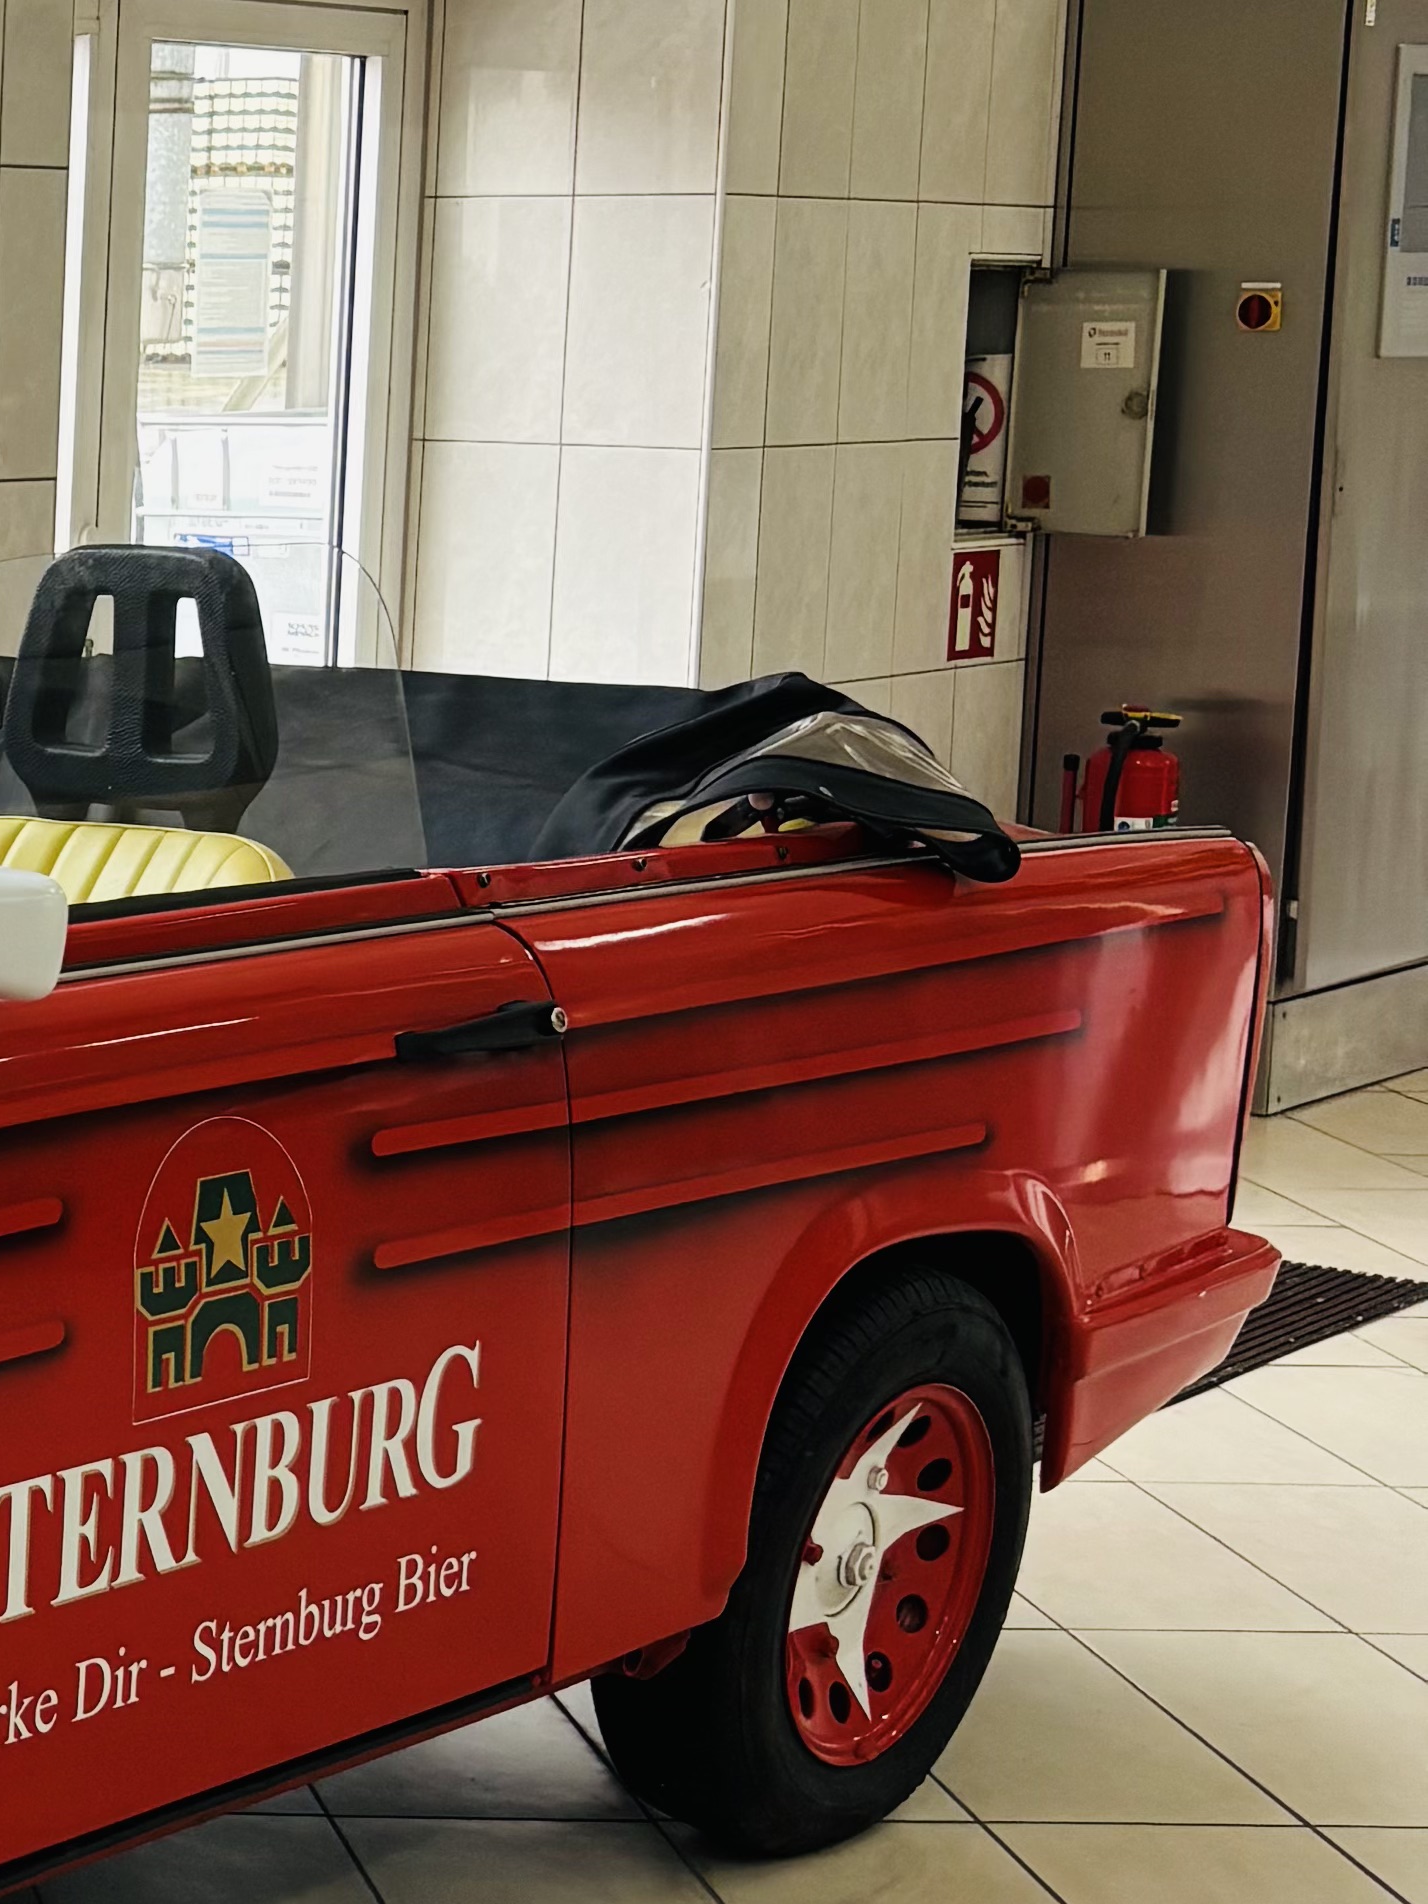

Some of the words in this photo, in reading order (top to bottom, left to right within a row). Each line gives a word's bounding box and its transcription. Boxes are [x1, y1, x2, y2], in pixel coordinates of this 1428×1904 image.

[71, 1646, 148, 1723] Dir
[190, 1580, 384, 1685] Sternburg
[394, 1544, 478, 1614] Bier
